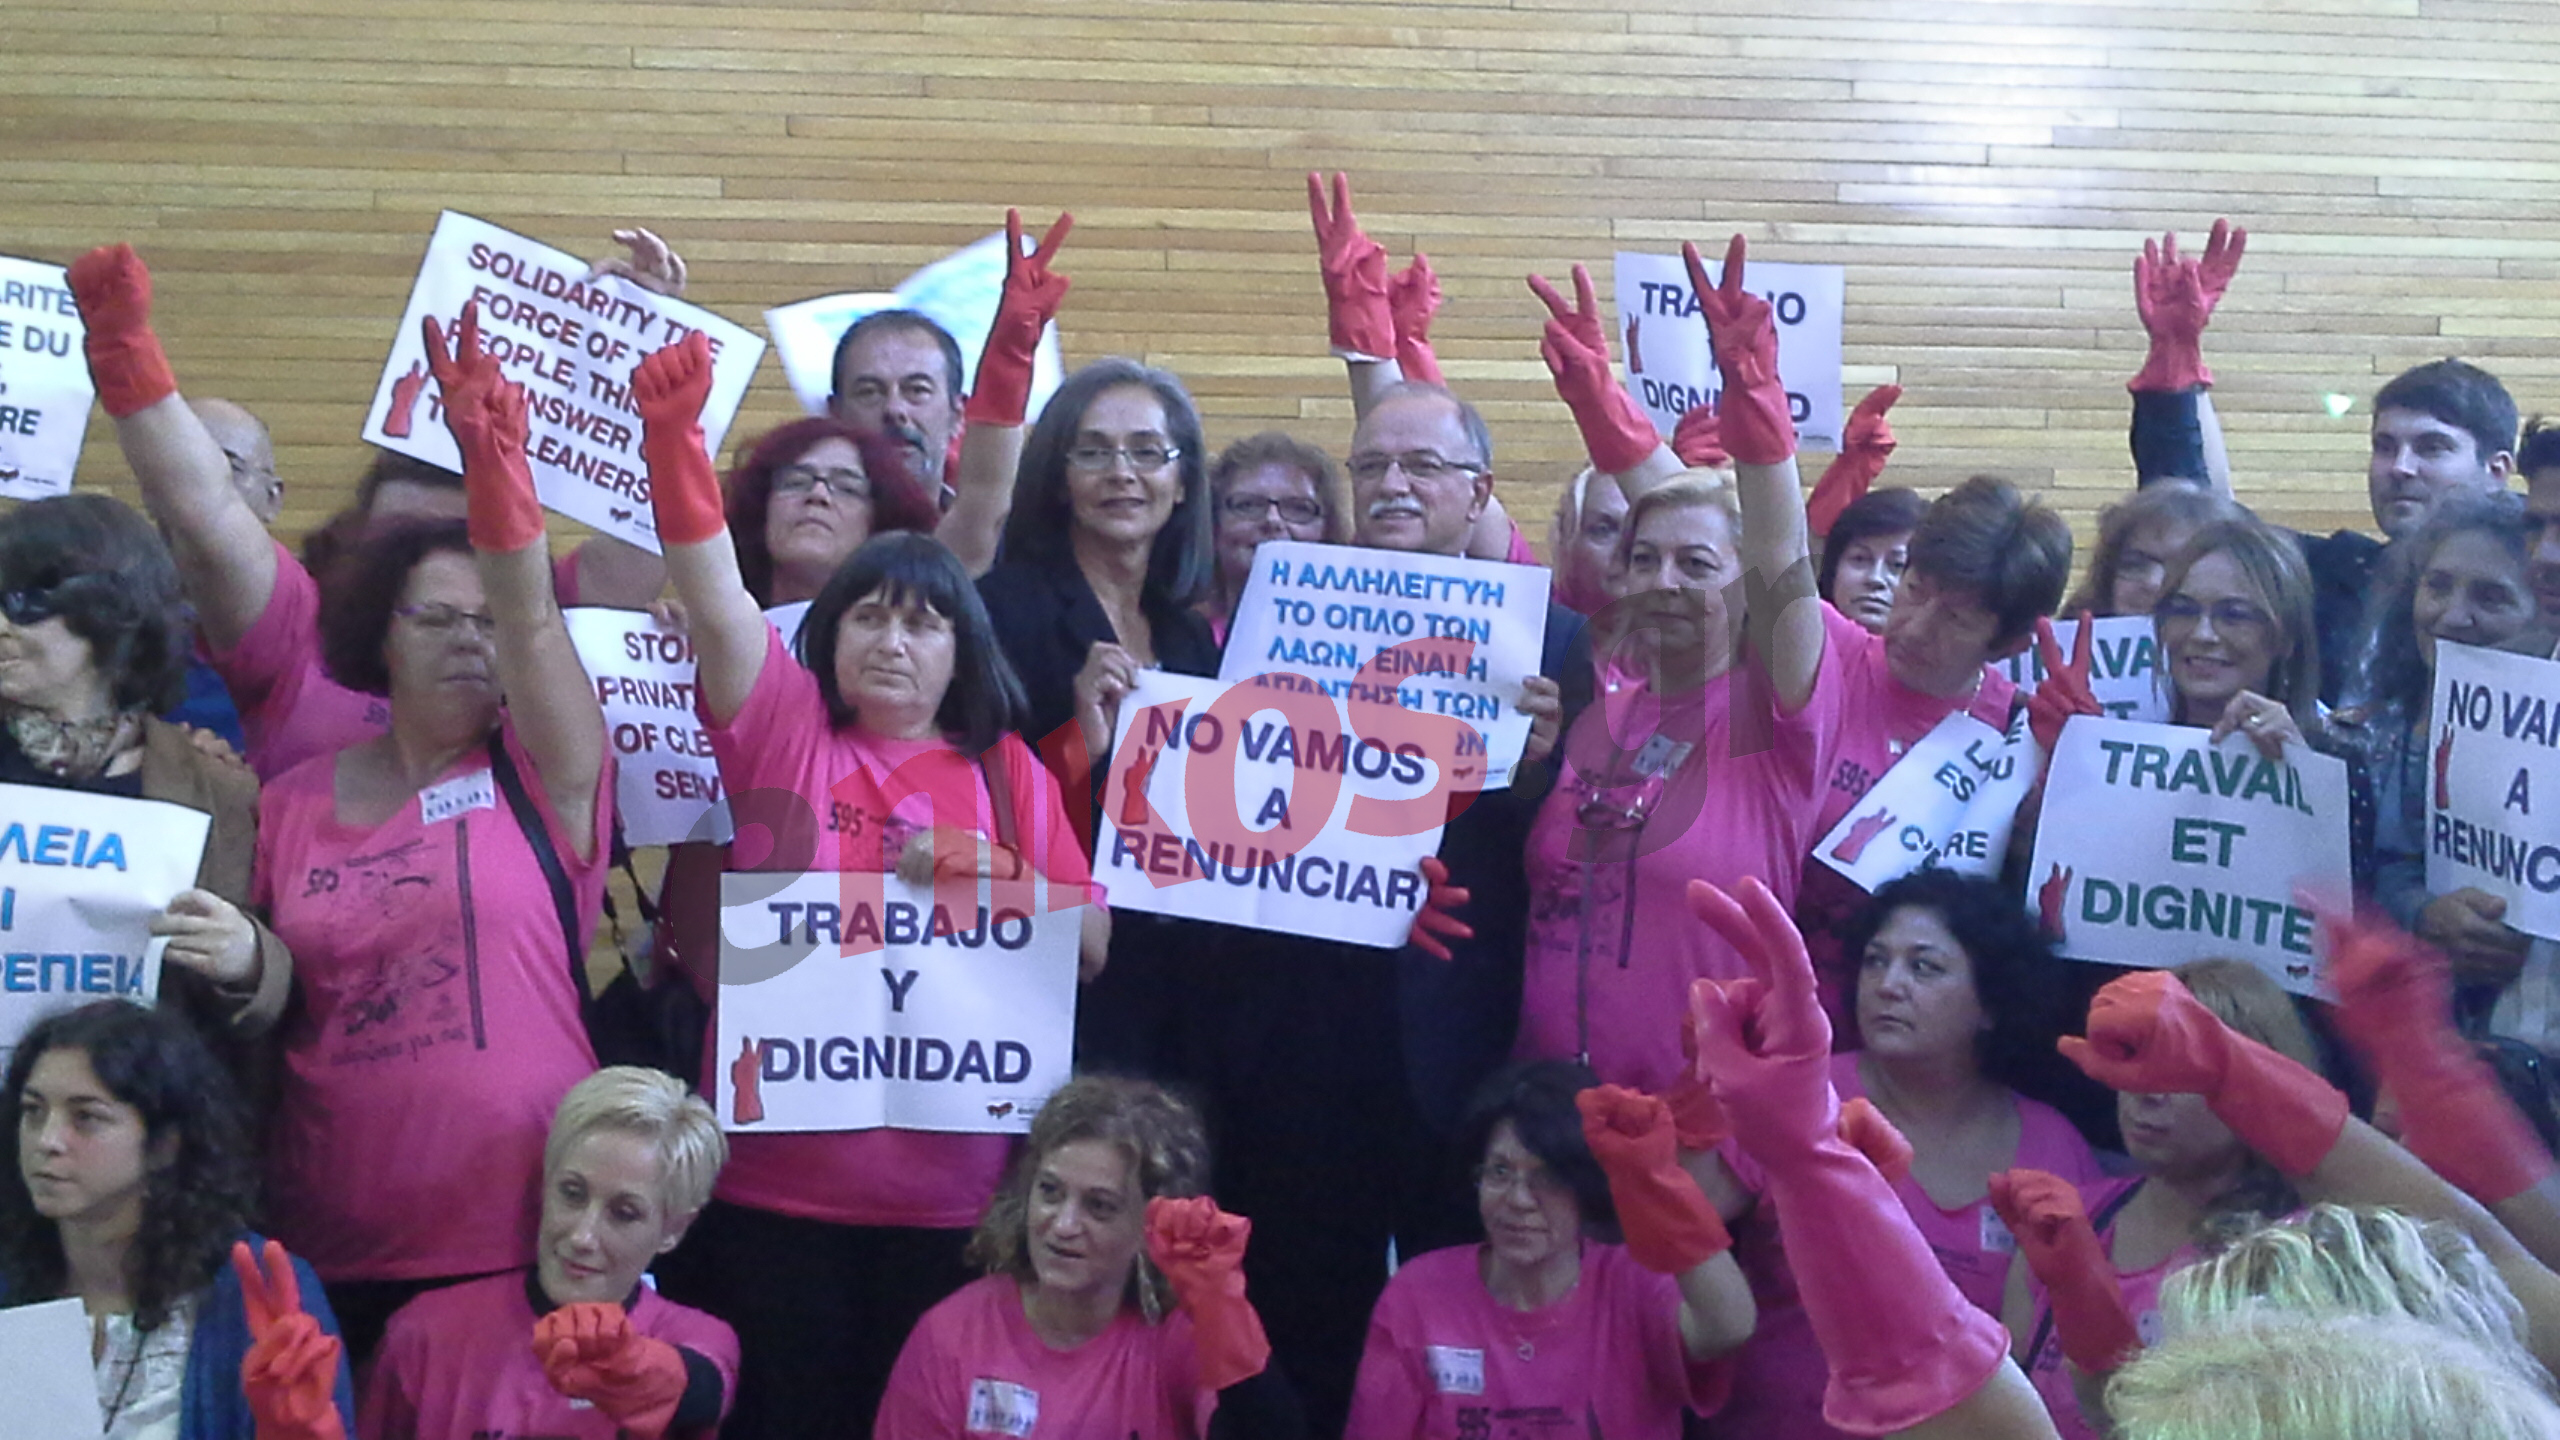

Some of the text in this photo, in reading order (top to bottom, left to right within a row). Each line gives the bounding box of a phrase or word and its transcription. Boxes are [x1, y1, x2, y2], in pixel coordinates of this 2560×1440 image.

[468, 243, 657, 334] SOLIDARITY
[1639, 281, 1807, 326] TRAO
[24, 325, 70, 357] DU
[471, 285, 583, 348] FORCE
[586, 331, 630, 362] OF
[527, 387, 633, 454] NSWER
[1270, 560, 1505, 608] Η ΑΛΛΗΛΕΓΓΥΗ
[1273, 597, 1491, 645] ΤΟ ΟΠΛΟ ΤΩΝ
[1267, 635, 1488, 683] ΛΑΩΝ, ΕΙΝΑΙ Η
[1432, 689, 1499, 721] ΤΩΝ
[2448, 679, 2492, 731] NO
[613, 722, 658, 754] OF
[1146, 706, 1223, 754] NO
[1240, 718, 1425, 785] VAMOS
[2101, 740, 2314, 816] TRAVAIL
[2504, 767, 2530, 815] A
[1255, 787, 1291, 830] A
[2172, 818, 2246, 868] ET
[1111, 827, 1421, 912] RENUNCIAR
[768, 901, 1033, 950] TRABAJO
[2081, 877, 2315, 955] DIGNITE
[881, 967, 919, 1012] Y
[761, 1036, 1032, 1084] DIGNIDAD
